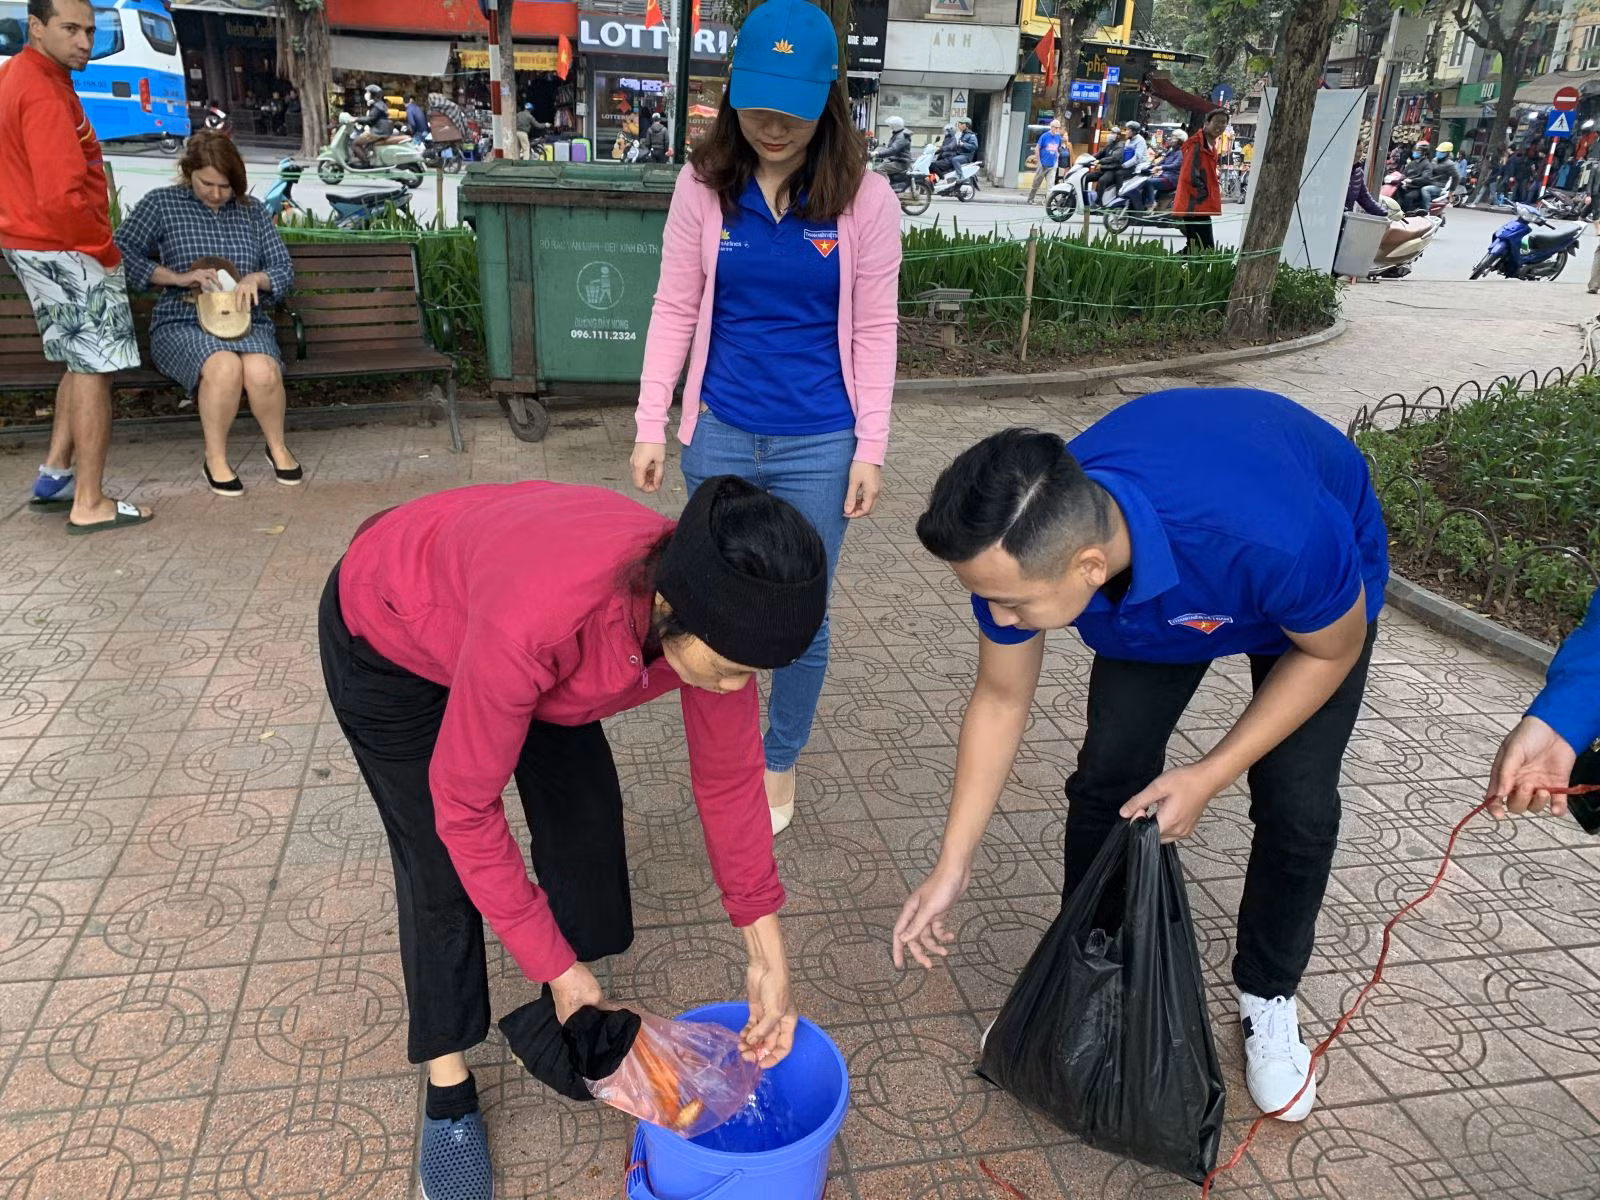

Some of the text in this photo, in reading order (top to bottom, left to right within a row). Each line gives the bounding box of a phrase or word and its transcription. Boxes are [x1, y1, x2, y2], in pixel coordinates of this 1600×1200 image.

[580, 20, 738, 54] LOTTRI
[862, 36, 879, 46] SHOP
[570, 329, 636, 340] 096.111.2324
